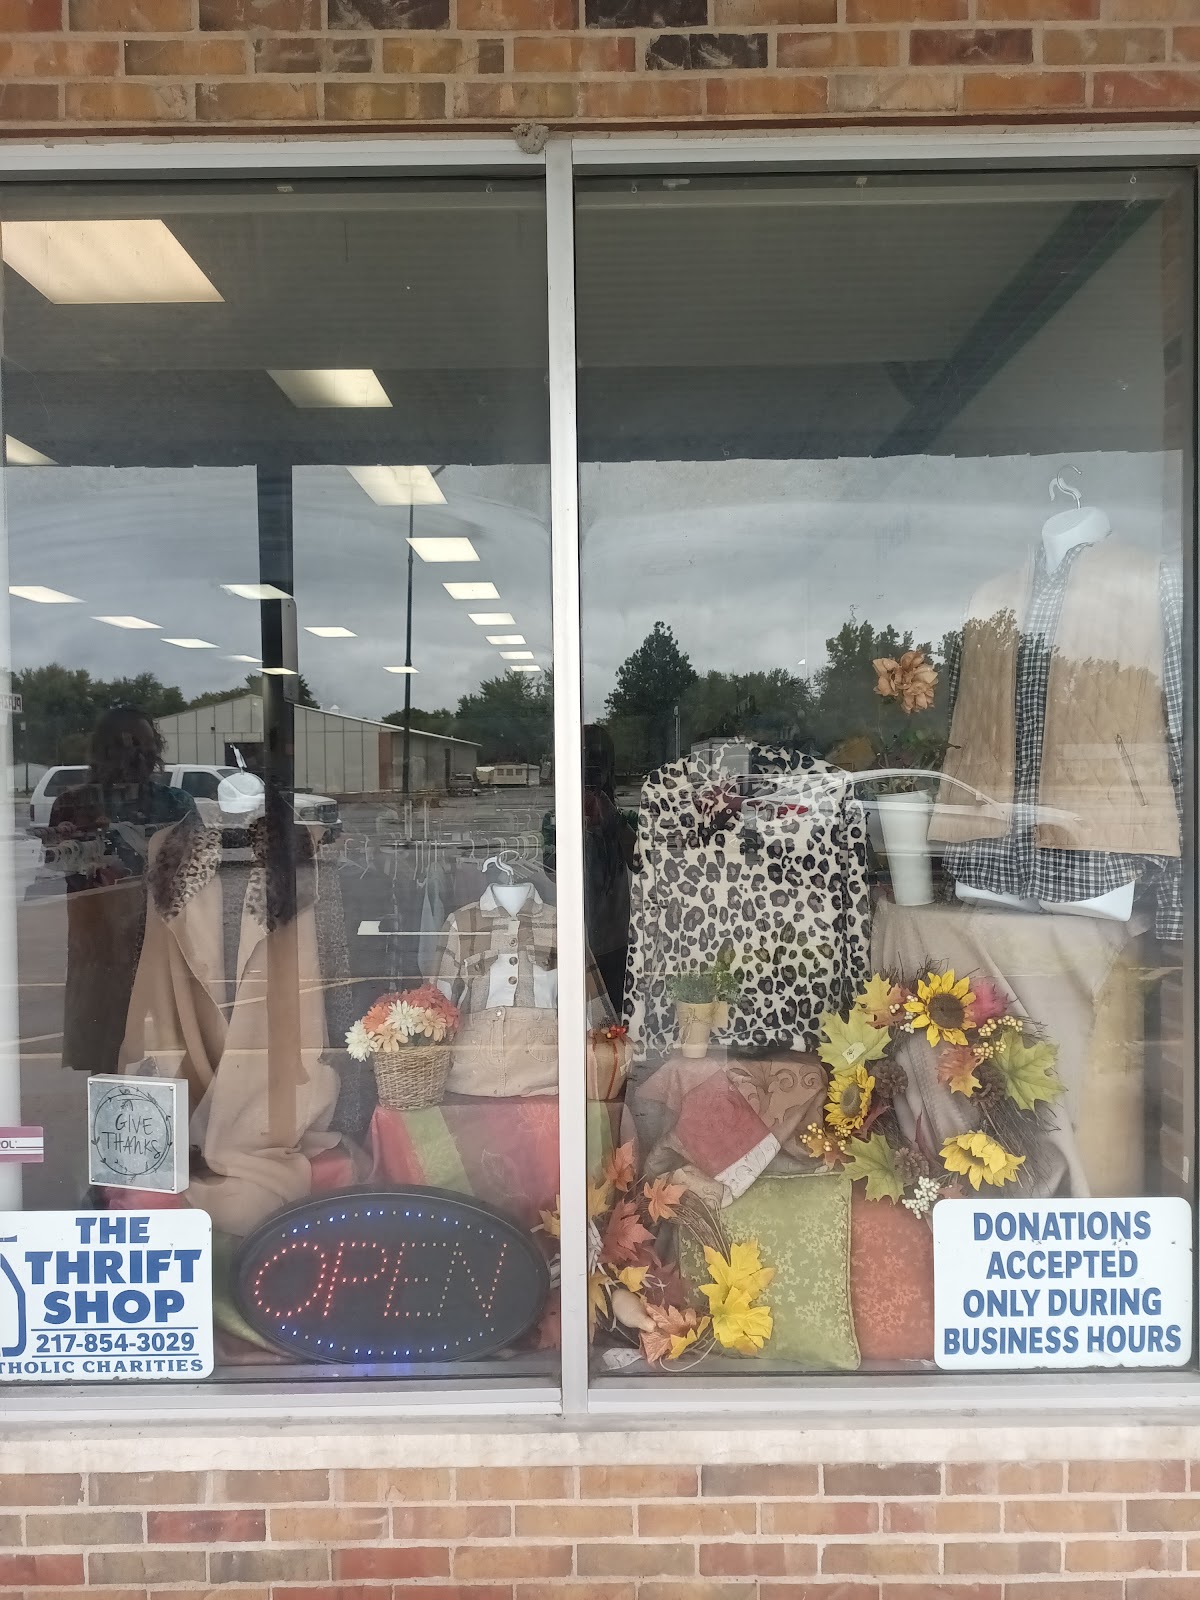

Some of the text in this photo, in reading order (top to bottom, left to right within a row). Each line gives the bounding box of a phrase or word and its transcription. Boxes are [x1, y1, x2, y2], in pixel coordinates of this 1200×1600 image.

[114, 1112, 153, 1136] GIVE
[101, 1131, 162, 1159] THANKS
[75, 1216, 150, 1244] THE
[973, 1210, 1152, 1241] DONATIONS
[25, 1249, 202, 1285] THRIFT
[254, 1241, 508, 1318] OPEN
[986, 1250, 1138, 1279] ACCEPTED
[43, 1289, 185, 1325] SHOP
[963, 1287, 1162, 1318] ONLY DURING
[36, 1332, 195, 1353] 217-854-3029
[944, 1324, 1182, 1356] BUSINESS HOURS
[82, 1359, 204, 1373] CHARITIES
